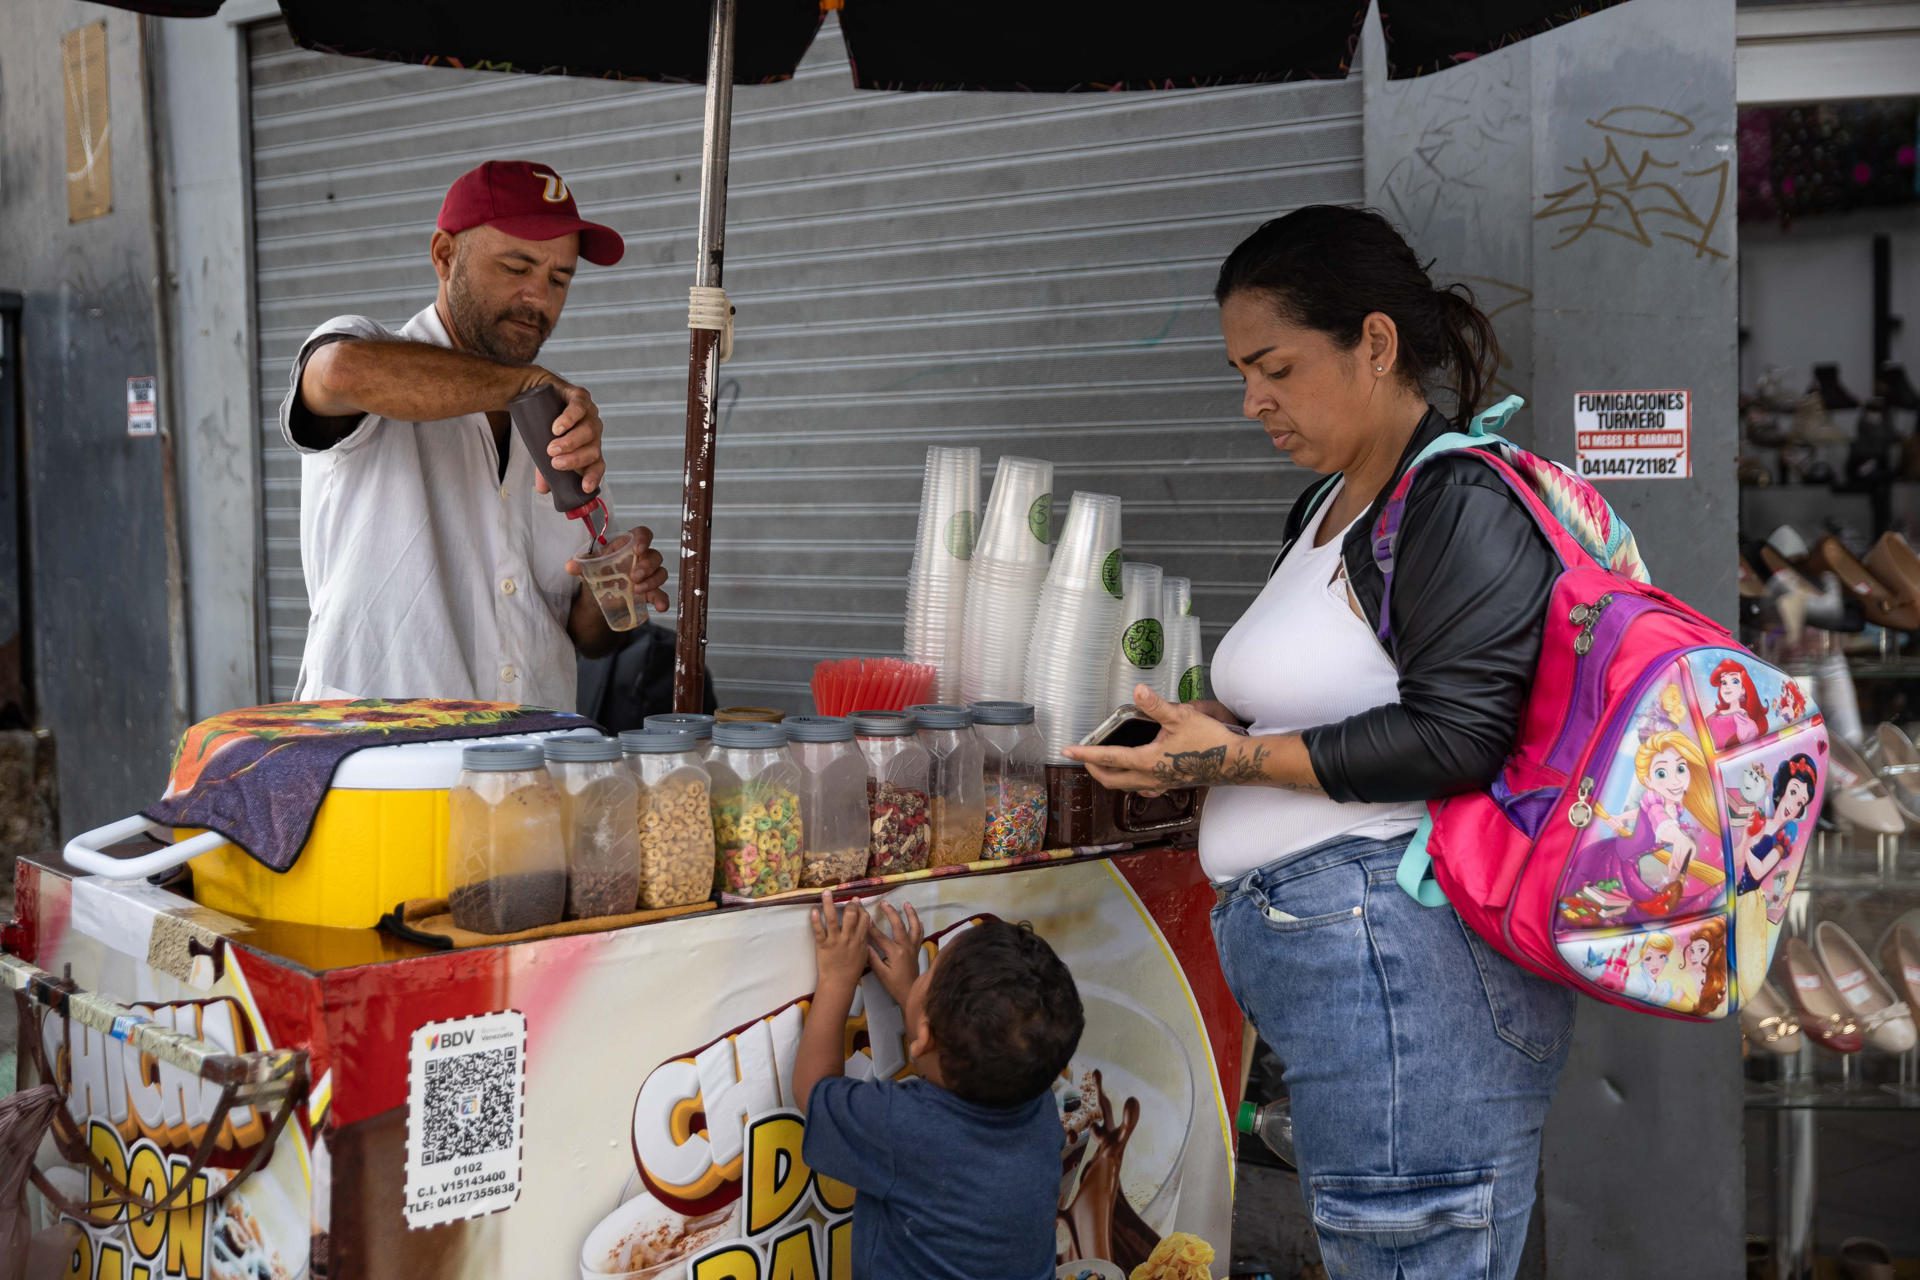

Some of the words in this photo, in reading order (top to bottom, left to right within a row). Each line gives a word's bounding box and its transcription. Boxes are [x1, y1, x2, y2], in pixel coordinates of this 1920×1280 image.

[1578, 393, 1684, 412] FUMIGACIONES
[1597, 412, 1665, 430] TURMERO
[1591, 433, 1624, 447] MESES
[1624, 433, 1638, 446] DE
[1582, 458, 1677, 475] 04144721182
[440, 1029, 475, 1049] BDV
[454, 1161, 483, 1176] 0102
[417, 1185, 437, 1198] C.I.
[441, 1170, 506, 1193] V15143400
[88, 1117, 209, 1280] DON
[407, 1201, 434, 1214] TLF:
[437, 1182, 515, 1208] 04127355638
